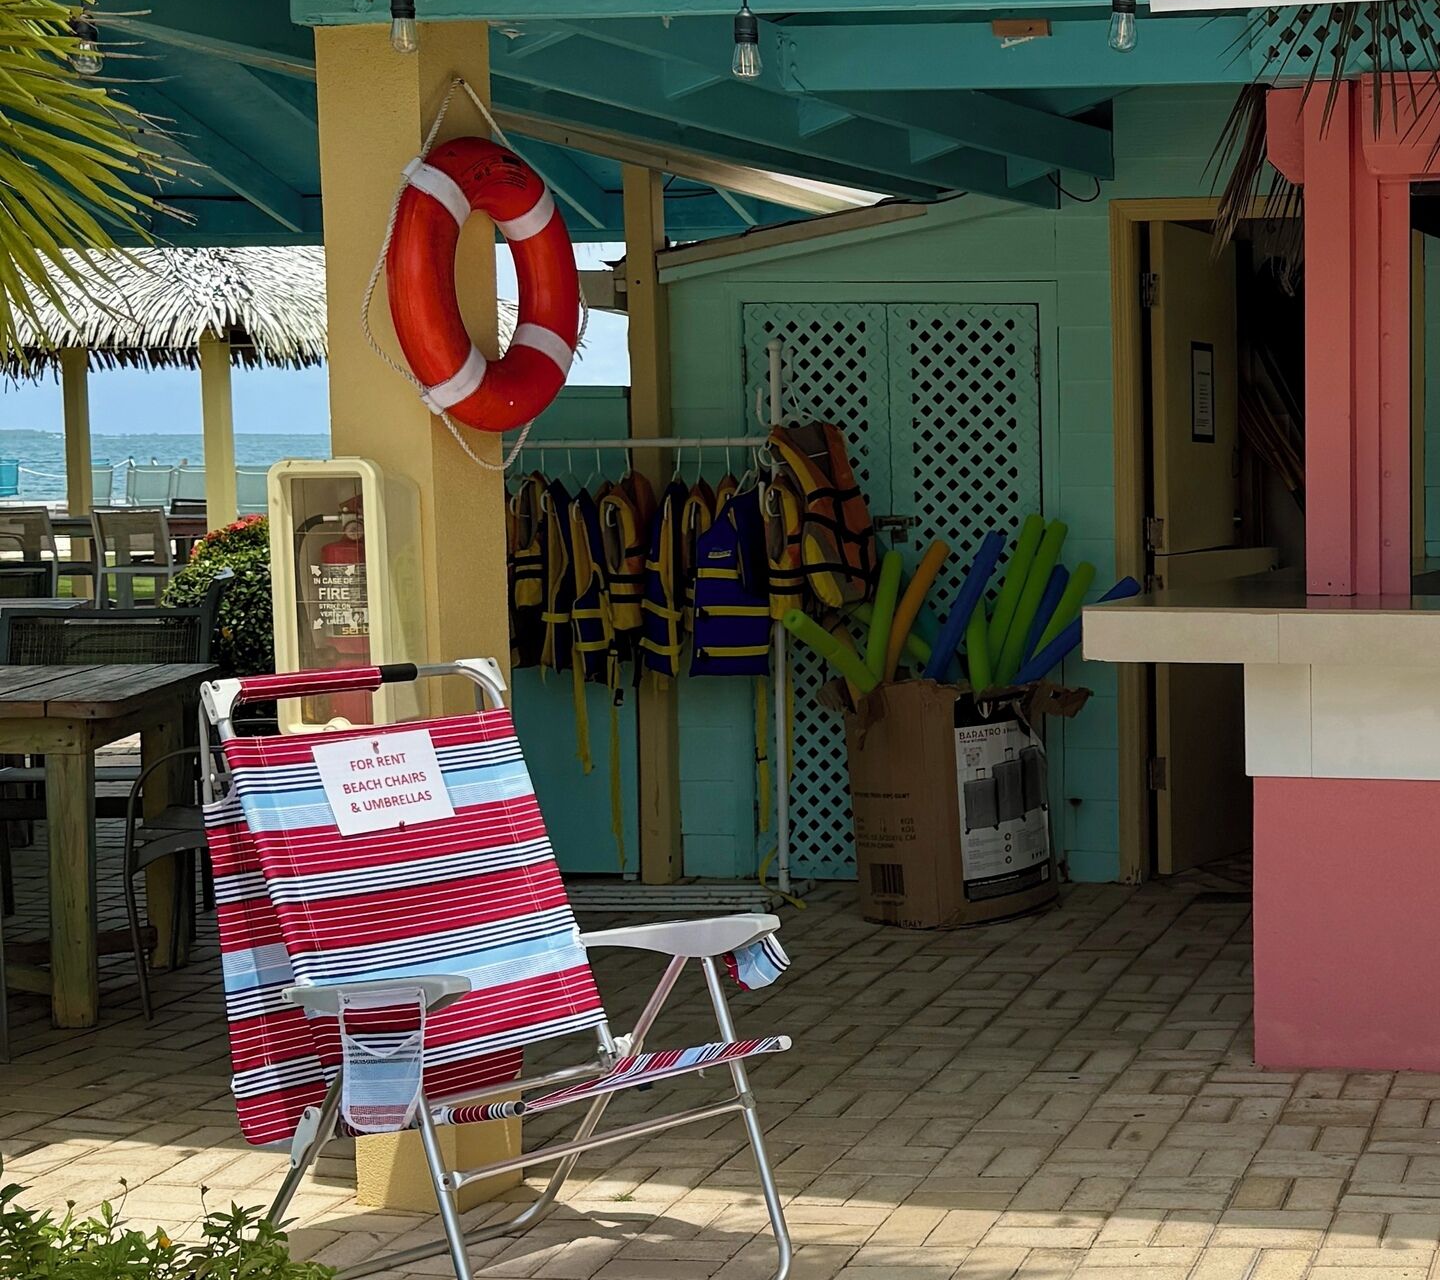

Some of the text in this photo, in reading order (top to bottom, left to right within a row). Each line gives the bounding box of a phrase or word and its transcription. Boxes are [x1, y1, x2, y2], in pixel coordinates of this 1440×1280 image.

[318, 587, 350, 600] FIRE
[959, 727, 1001, 740] BARATRO
[350, 753, 407, 772] FOR RENT
[343, 771, 427, 795] BEACH CHAIRS
[350, 790, 432, 813] & UMBRELLAS
